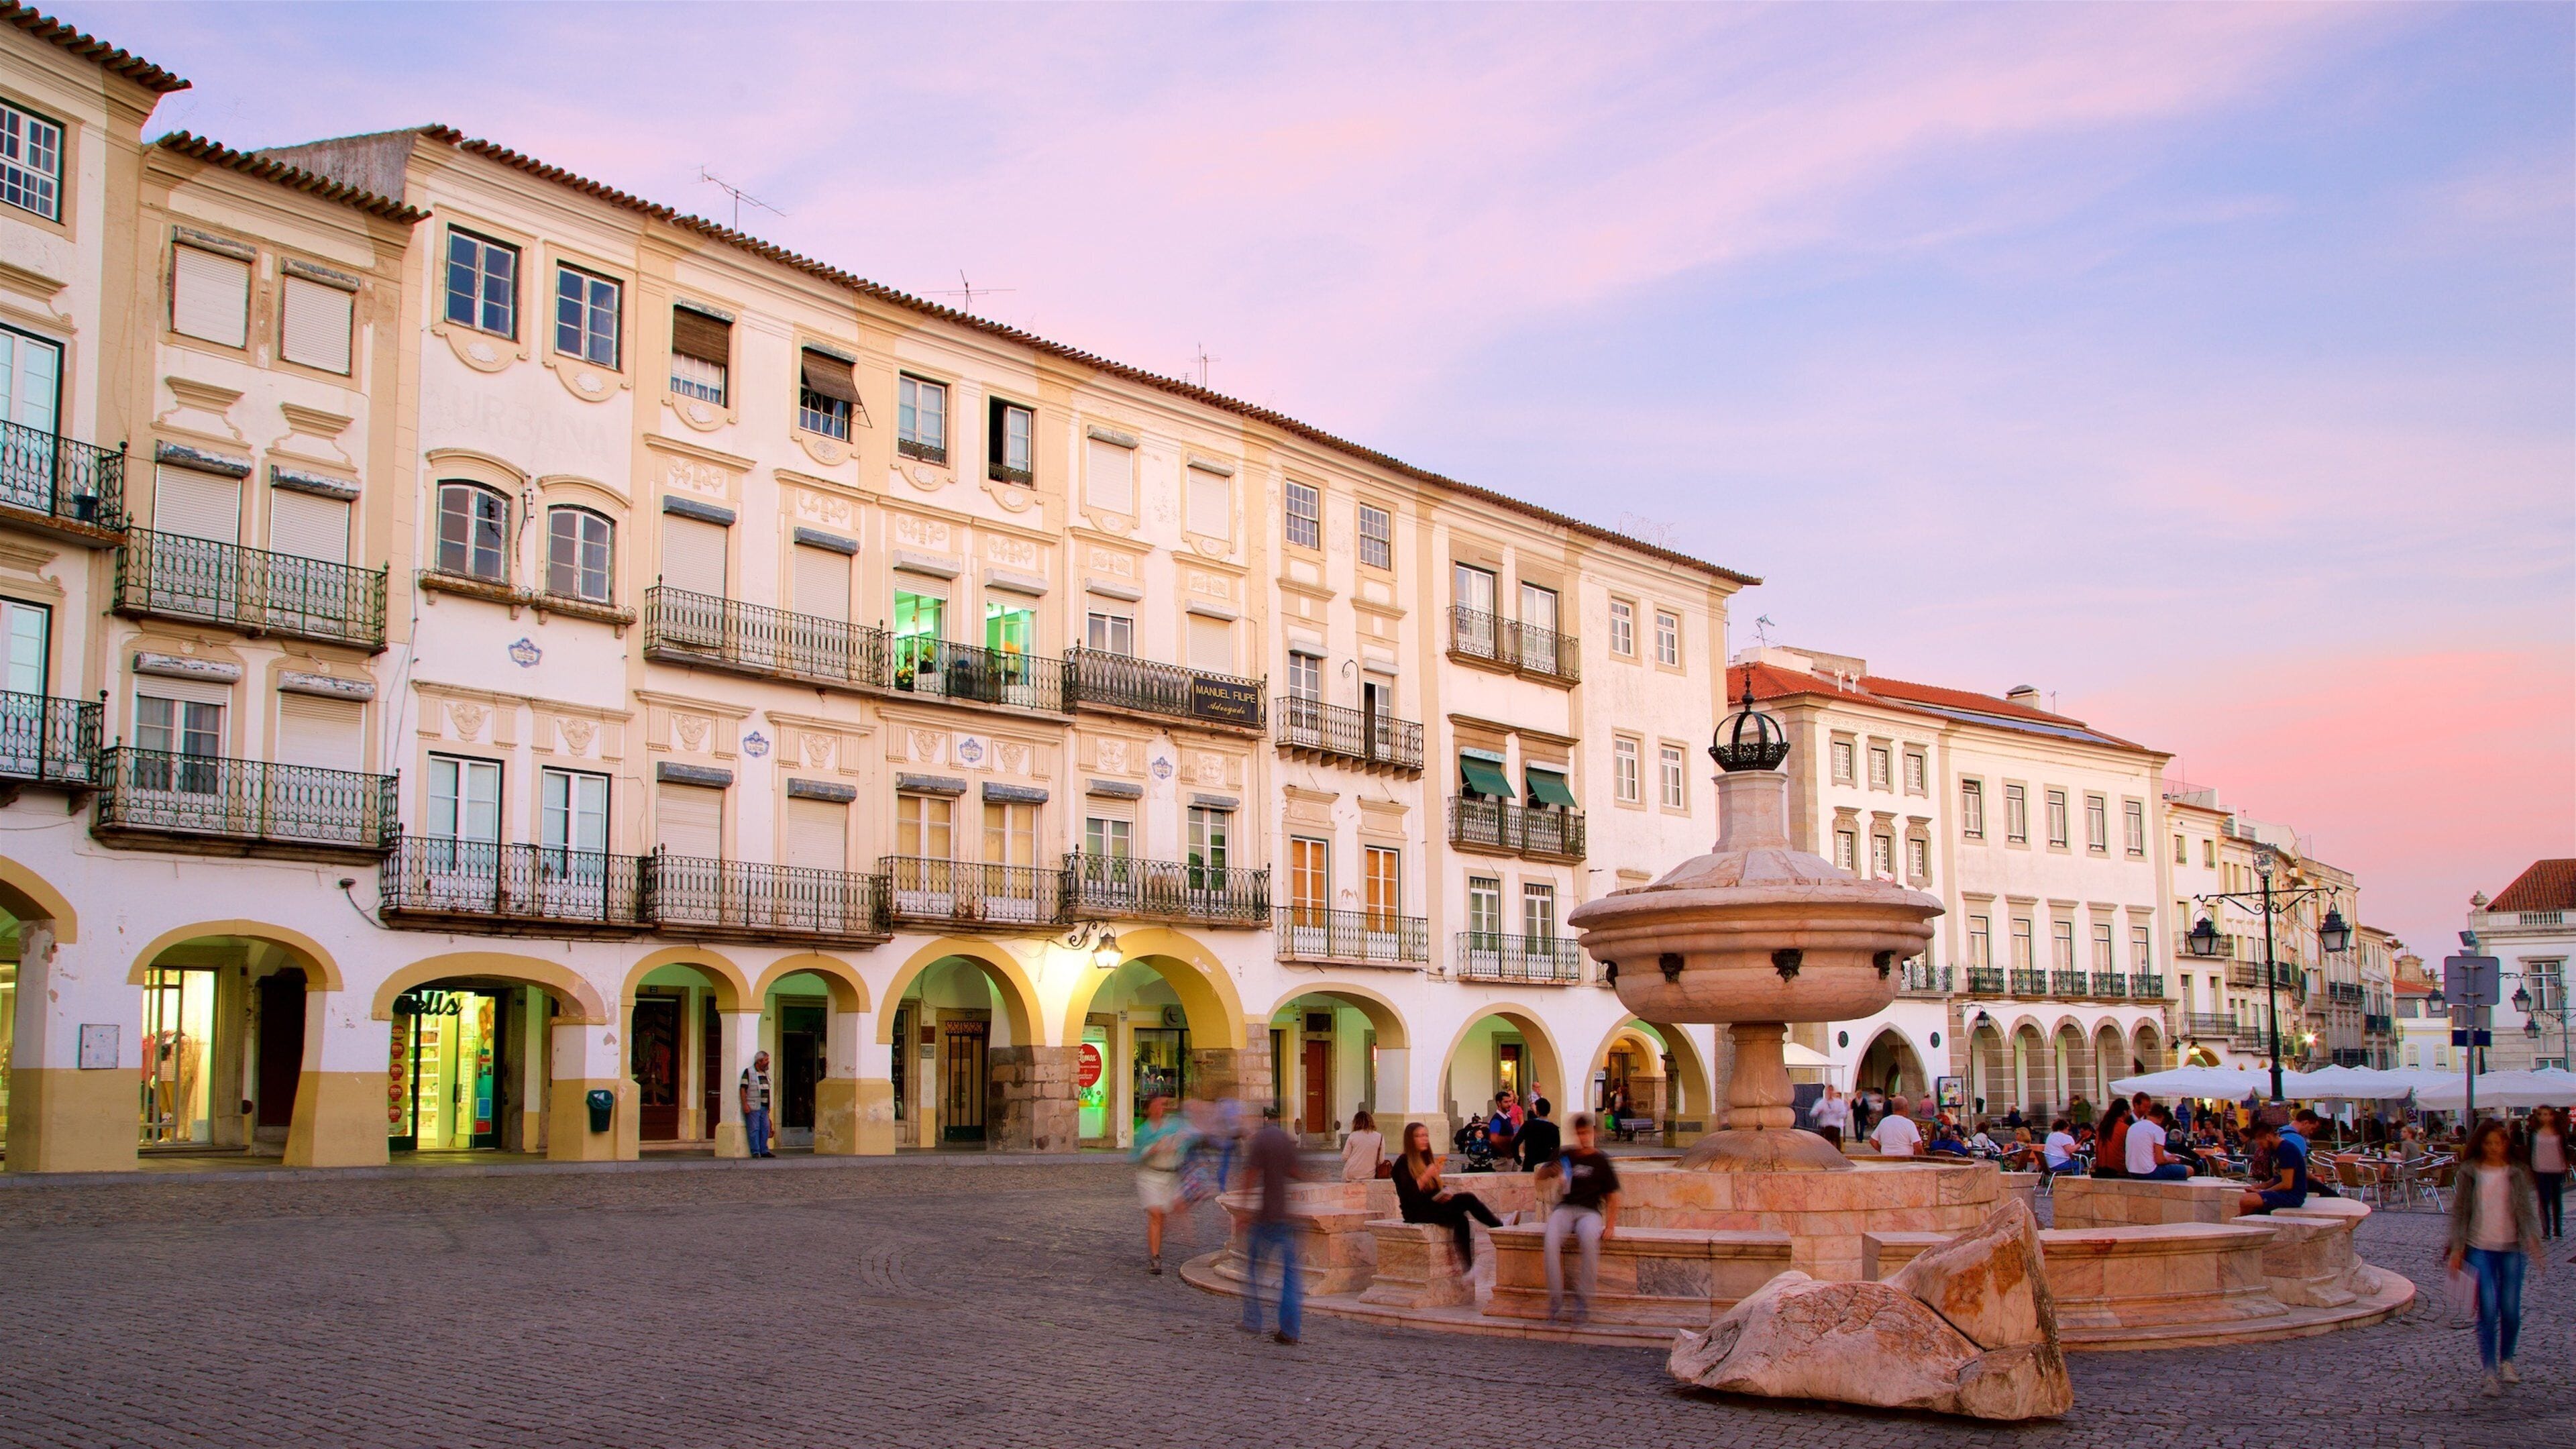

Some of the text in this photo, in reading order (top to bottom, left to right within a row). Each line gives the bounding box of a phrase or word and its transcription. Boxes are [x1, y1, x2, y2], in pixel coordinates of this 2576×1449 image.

[452, 384, 610, 464] URBANA
[1195, 685, 1256, 703] MANUEL FILIPE
[1208, 702, 1245, 715] Advogado
